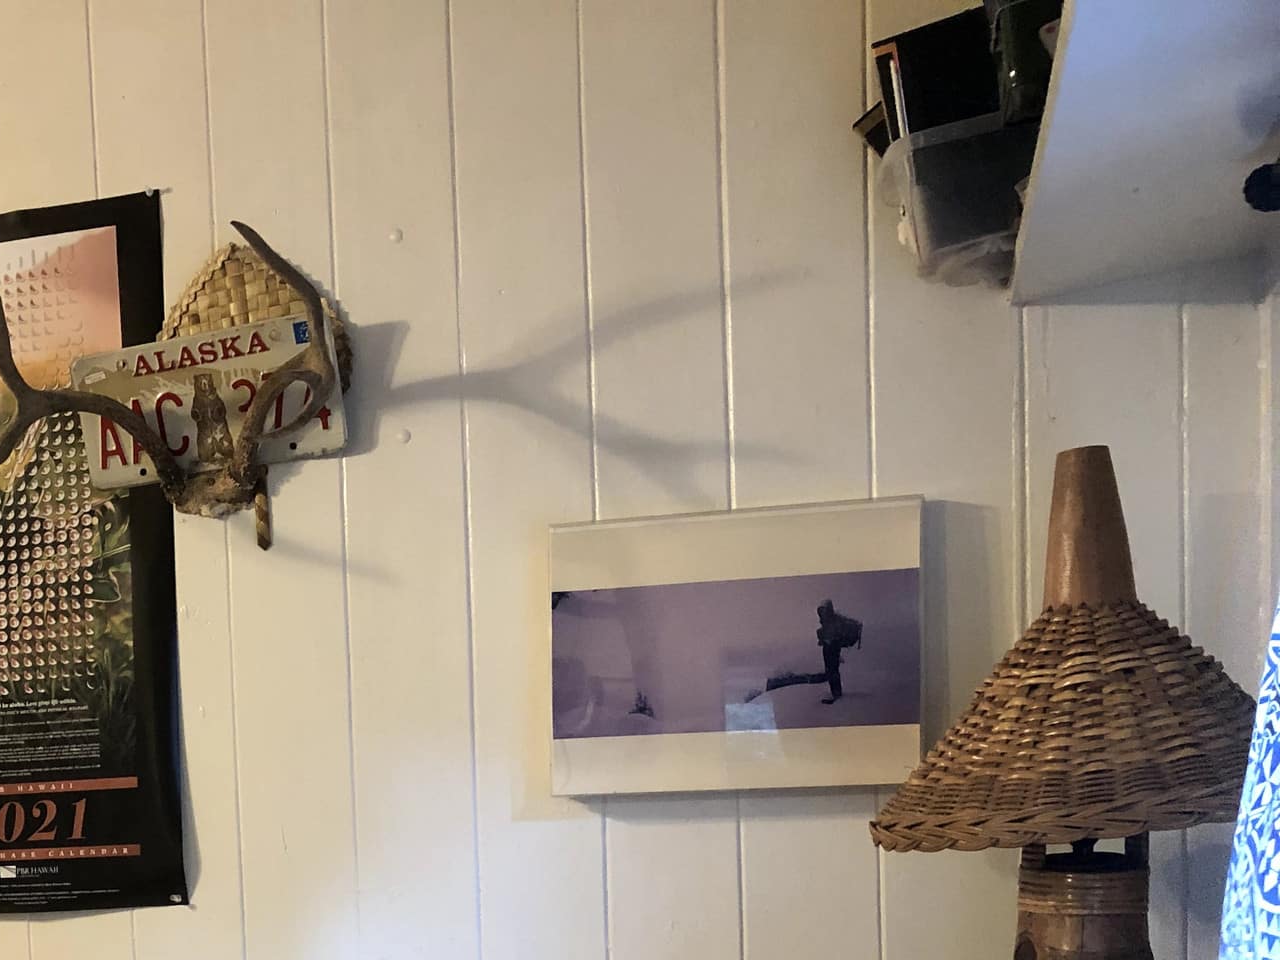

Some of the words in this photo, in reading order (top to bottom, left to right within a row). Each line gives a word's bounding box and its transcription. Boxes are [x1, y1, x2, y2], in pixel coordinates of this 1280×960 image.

[133, 330, 270, 377] ALASKA
[17, 782, 73, 792] HAWAII
[48, 847, 129, 857] CALENDAR
